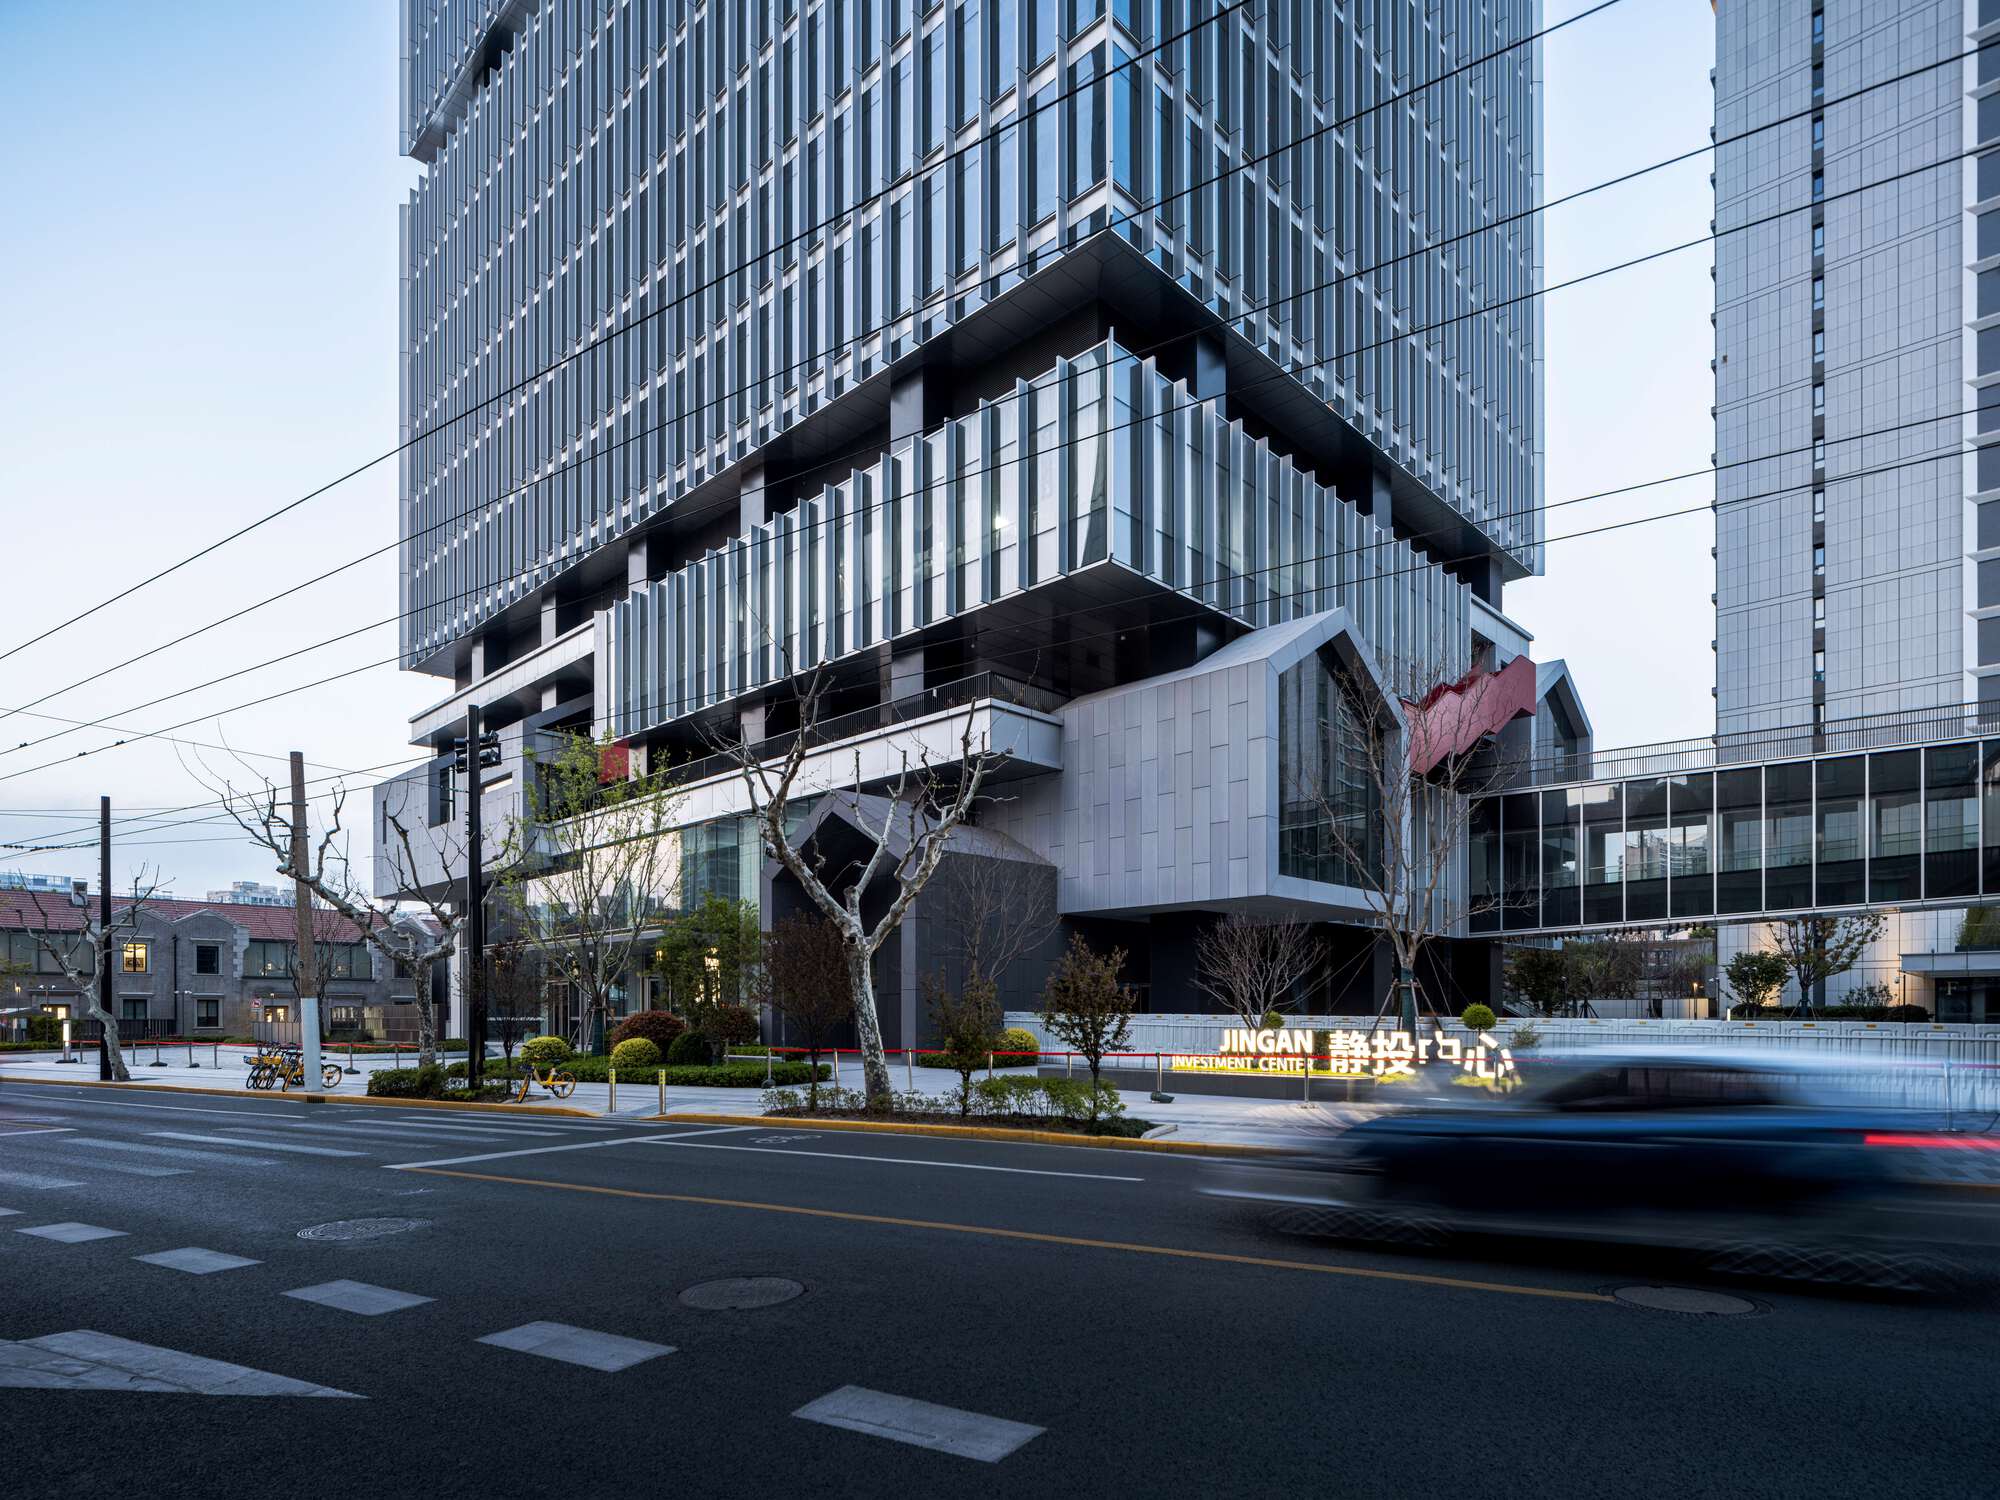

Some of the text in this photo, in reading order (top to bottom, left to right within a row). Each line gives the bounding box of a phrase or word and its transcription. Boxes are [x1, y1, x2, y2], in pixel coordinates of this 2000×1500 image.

[1219, 1029, 1314, 1054] JINGAN
[1171, 1055, 1314, 1073] INVESTMENT CENTER
